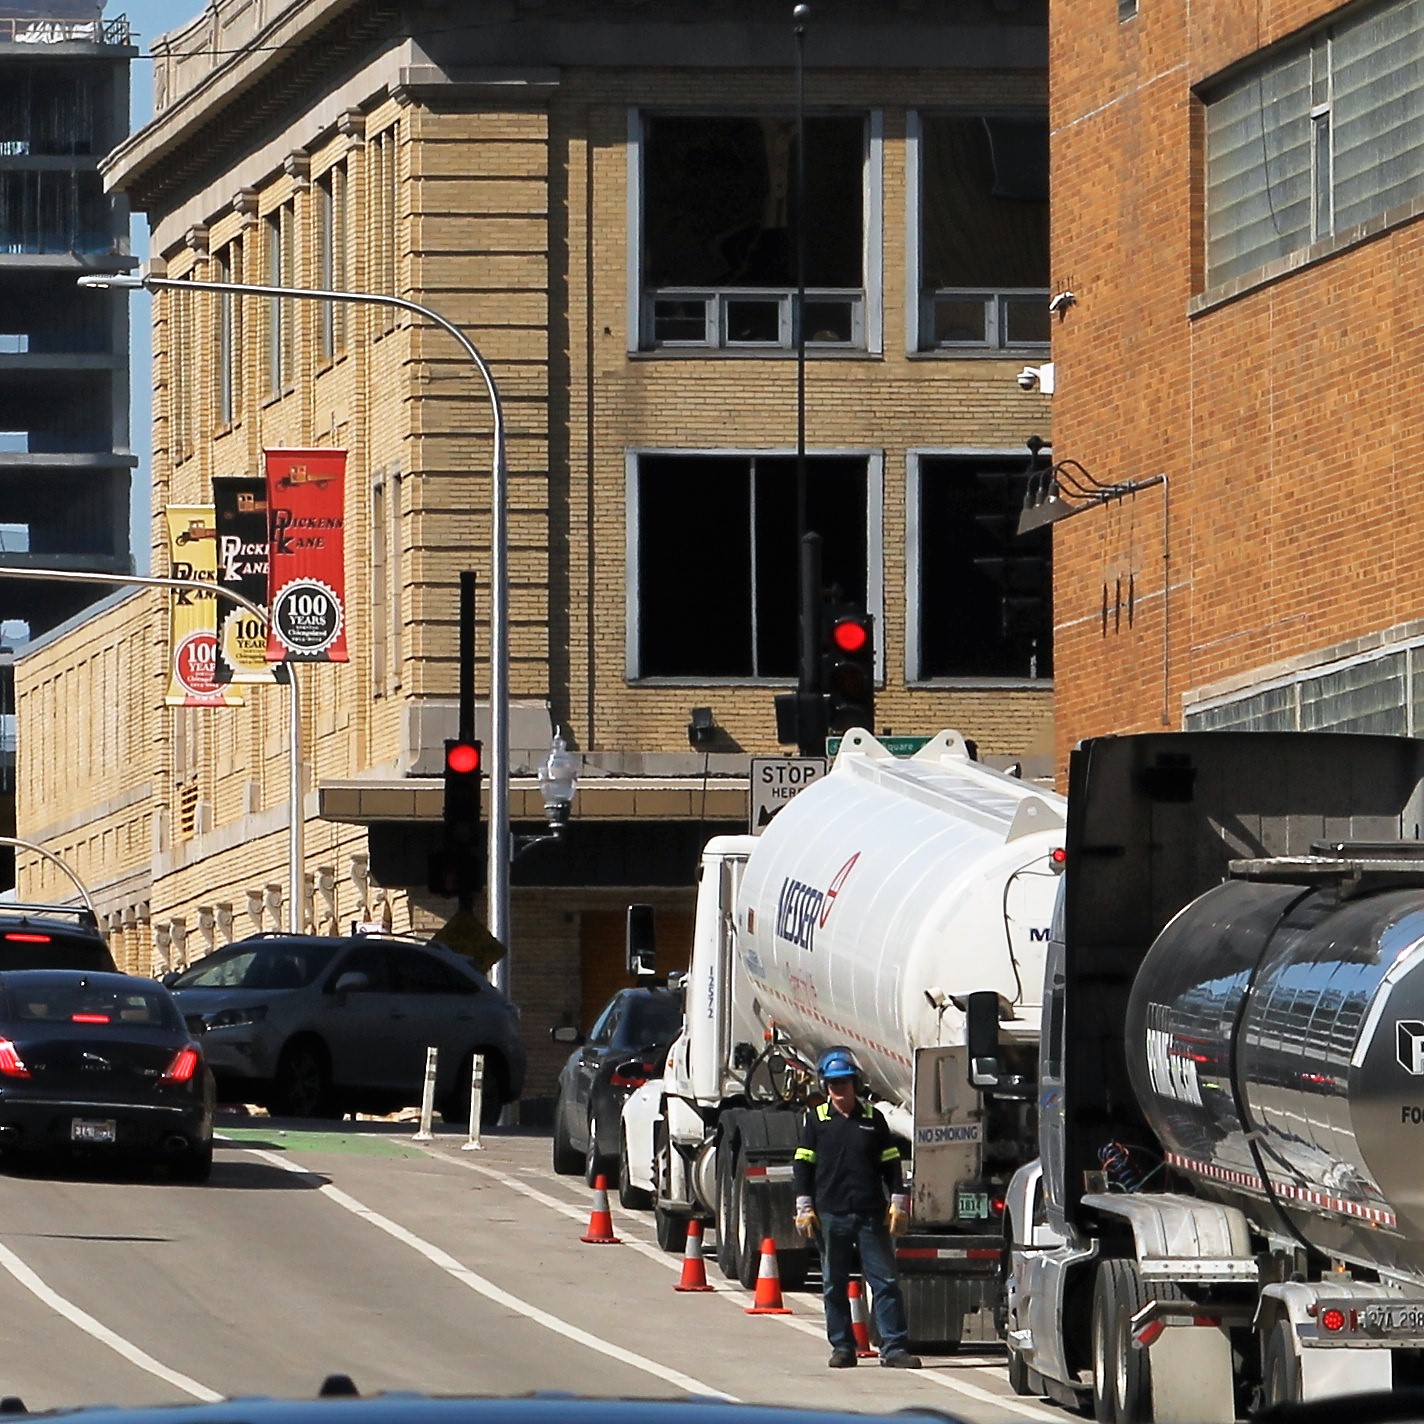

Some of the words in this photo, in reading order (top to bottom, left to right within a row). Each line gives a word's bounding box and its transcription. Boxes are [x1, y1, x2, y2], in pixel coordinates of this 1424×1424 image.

[287, 594, 328, 616] 100
[289, 615, 326, 626] YEARS
[882, 741, 914, 753] quare
[762, 766, 816, 784] STOP
[777, 876, 824, 953] MESSER
[1401, 1105, 1424, 1125] FO
[918, 1127, 933, 1143] NO
[935, 1125, 978, 1142] SMOKING
